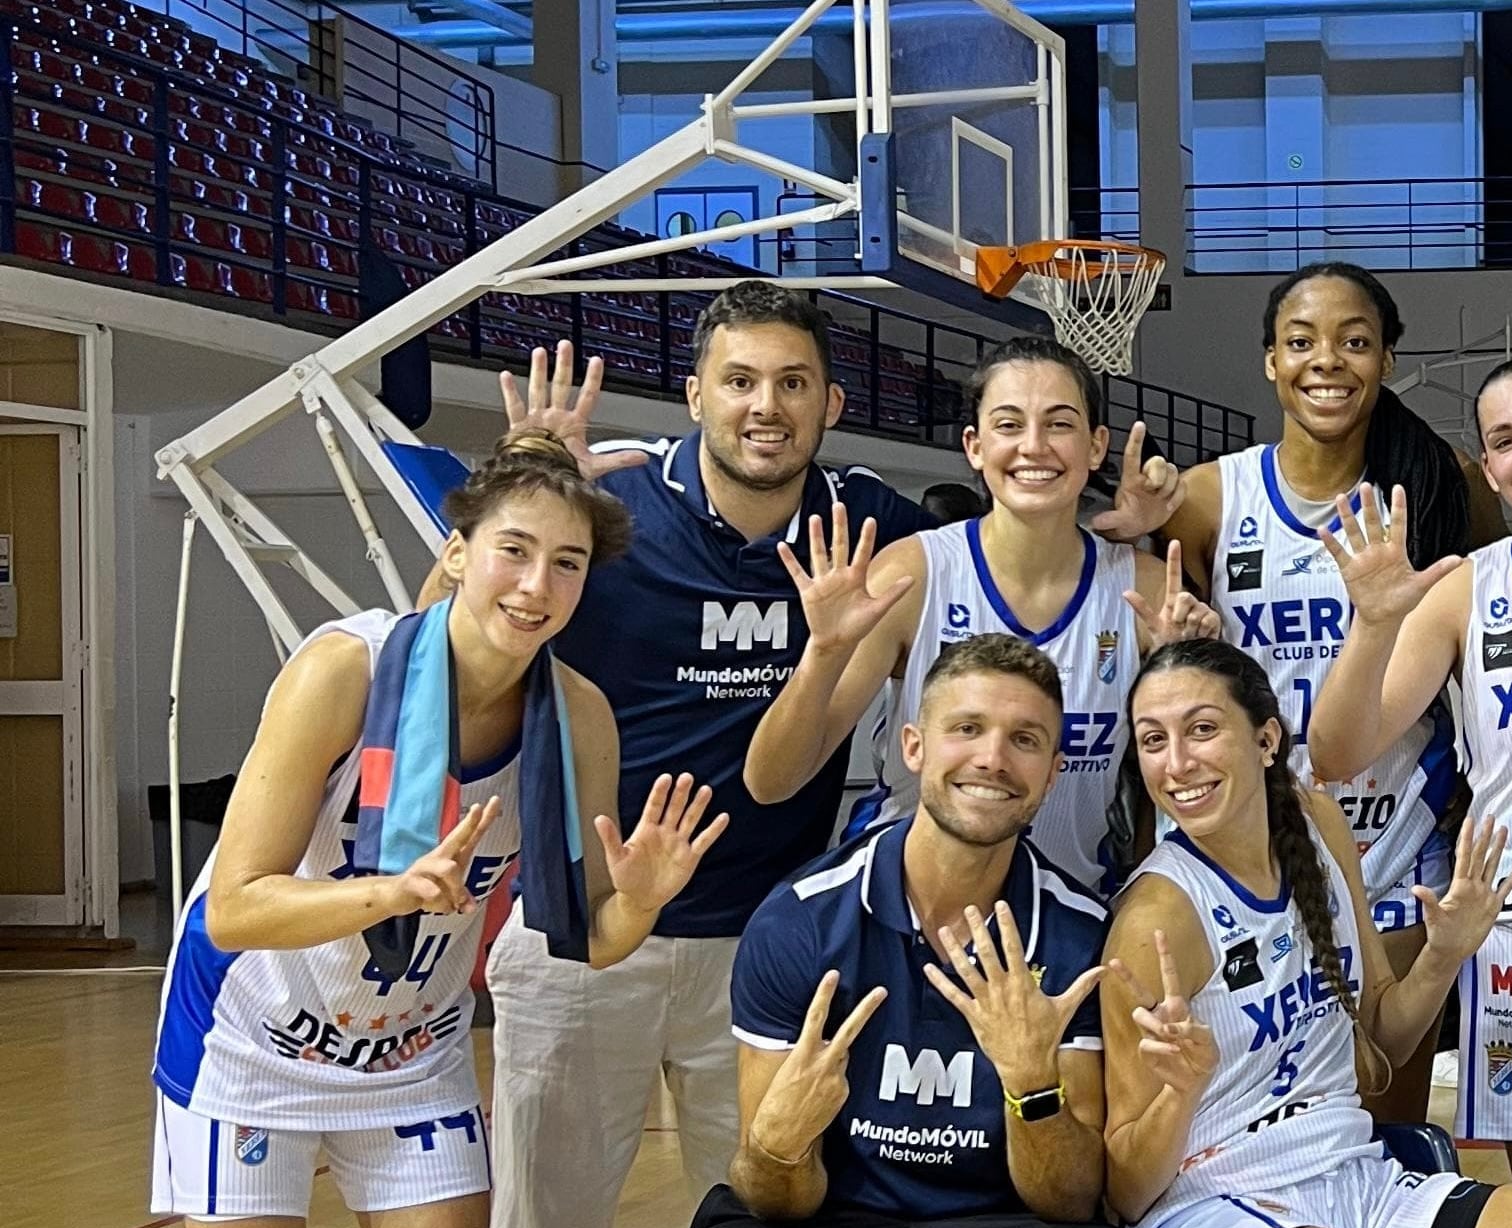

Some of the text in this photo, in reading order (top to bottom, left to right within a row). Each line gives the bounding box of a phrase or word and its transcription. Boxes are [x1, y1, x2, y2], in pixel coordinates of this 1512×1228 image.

[701, 601, 788, 650] MM
[1233, 597, 1355, 648] XER
[1273, 647, 1313, 661] CLUB
[676, 663, 793, 683] MundoMÓVI
[705, 684, 772, 699] Network
[1291, 678, 1312, 745] 1
[879, 1043, 974, 1107] MM
[850, 1117, 991, 1149] MundoMÓVIL
[879, 1144, 953, 1165] Network
